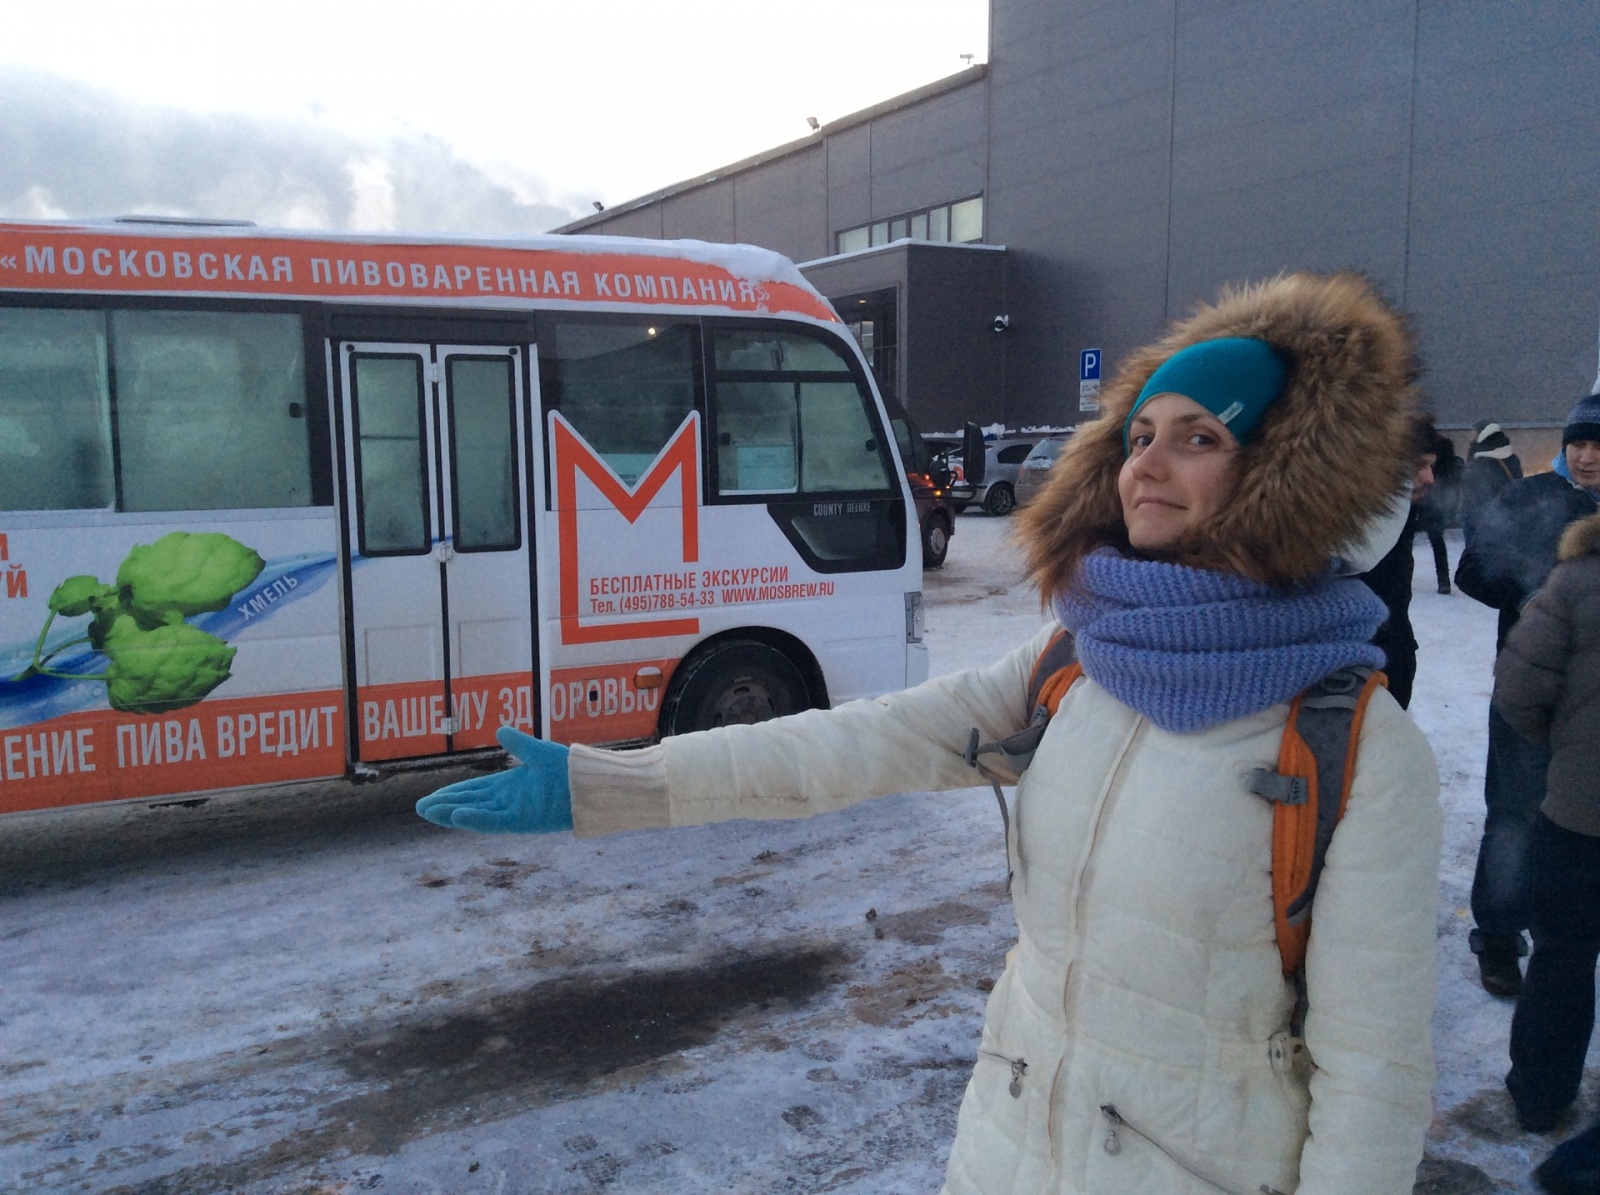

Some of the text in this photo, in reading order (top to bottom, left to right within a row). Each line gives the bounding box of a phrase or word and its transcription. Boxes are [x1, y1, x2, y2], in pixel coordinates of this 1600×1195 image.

[311, 257, 581, 296] ПИВОВАРЕННАЯ
[1084, 352, 1097, 378] P
[813, 501, 872, 517] COUNTY DELUXE
[0, 563, 28, 599] Й
[237, 572, 299, 621] ХМЕЛЬ
[590, 566, 789, 596] БЕСПЛАТНЫЕ ЭКСКУРСИИ
[590, 582, 835, 614] Тел. (495)788-54-33 WWW.MOSBREW.RU
[0, 727, 97, 781] ЕНИЕ
[116, 718, 207, 769] ПИВА
[216, 705, 339, 759] ВРЕДИТ
[363, 689, 489, 742] ВАШЕМУ
